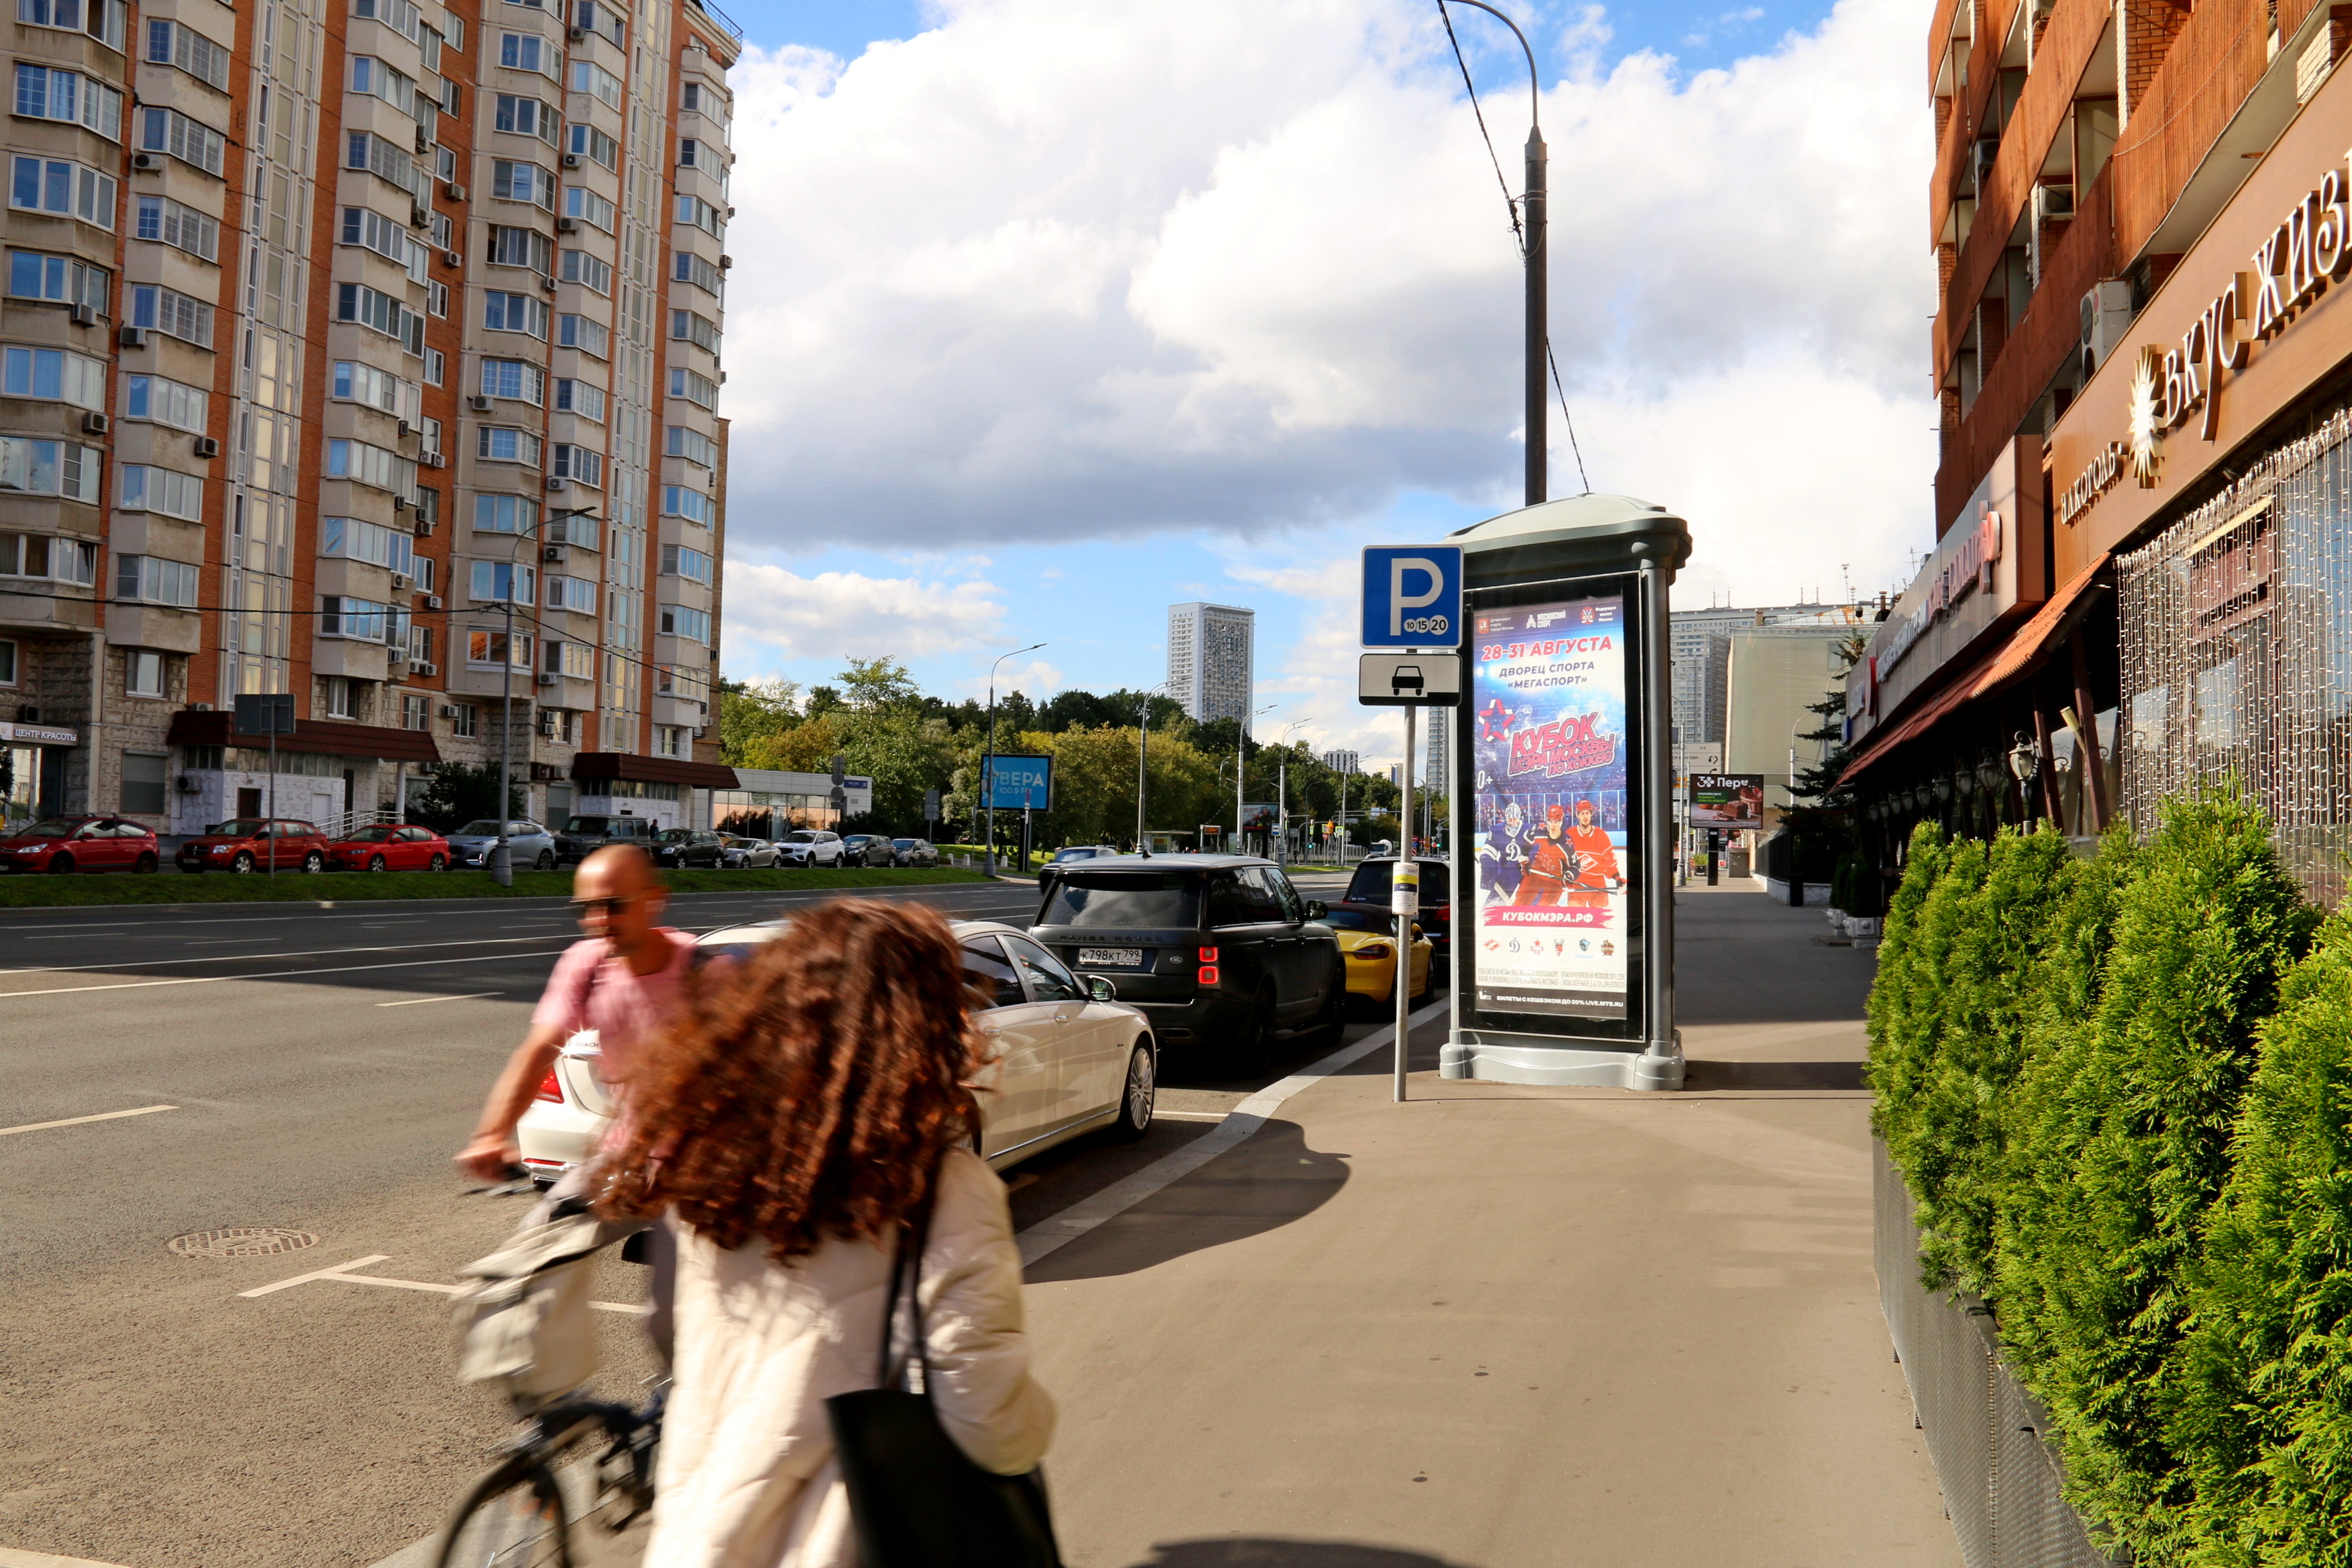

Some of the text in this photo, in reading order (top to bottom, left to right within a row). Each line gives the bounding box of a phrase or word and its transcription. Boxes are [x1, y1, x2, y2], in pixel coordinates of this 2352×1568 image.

[2164, 272, 2239, 440] ВКУС
[2251, 148, 2352, 340] ЖИЗ
[1390, 558, 1444, 636] P
[1537, 610, 1566, 620] МОСКОВСКИЙ
[1418, 620, 1427, 630] 15
[1431, 620, 1446, 631] 20
[1537, 620, 1551, 629] СПОРТ
[1482, 636, 1612, 662] 28-31 АВГУСТА
[1499, 661, 1595, 678] ДВОРЕЦ СПОРТА
[1507, 676, 1587, 689] «МЕГАСПОРТ»
[15, 729, 77, 741] ЦЕНТР КРАСОТЫ
[1511, 712, 1598, 758] КУБОК
[1509, 734, 1614, 774] МЭРА МОСКВЫ
[1547, 751, 1613, 776] ПО ХОККЕЮ
[999, 771, 1044, 787] ВЕРА
[1502, 912, 1594, 923] КУБОКМЭРА.РФ
[1124, 950, 1139, 959] 799
